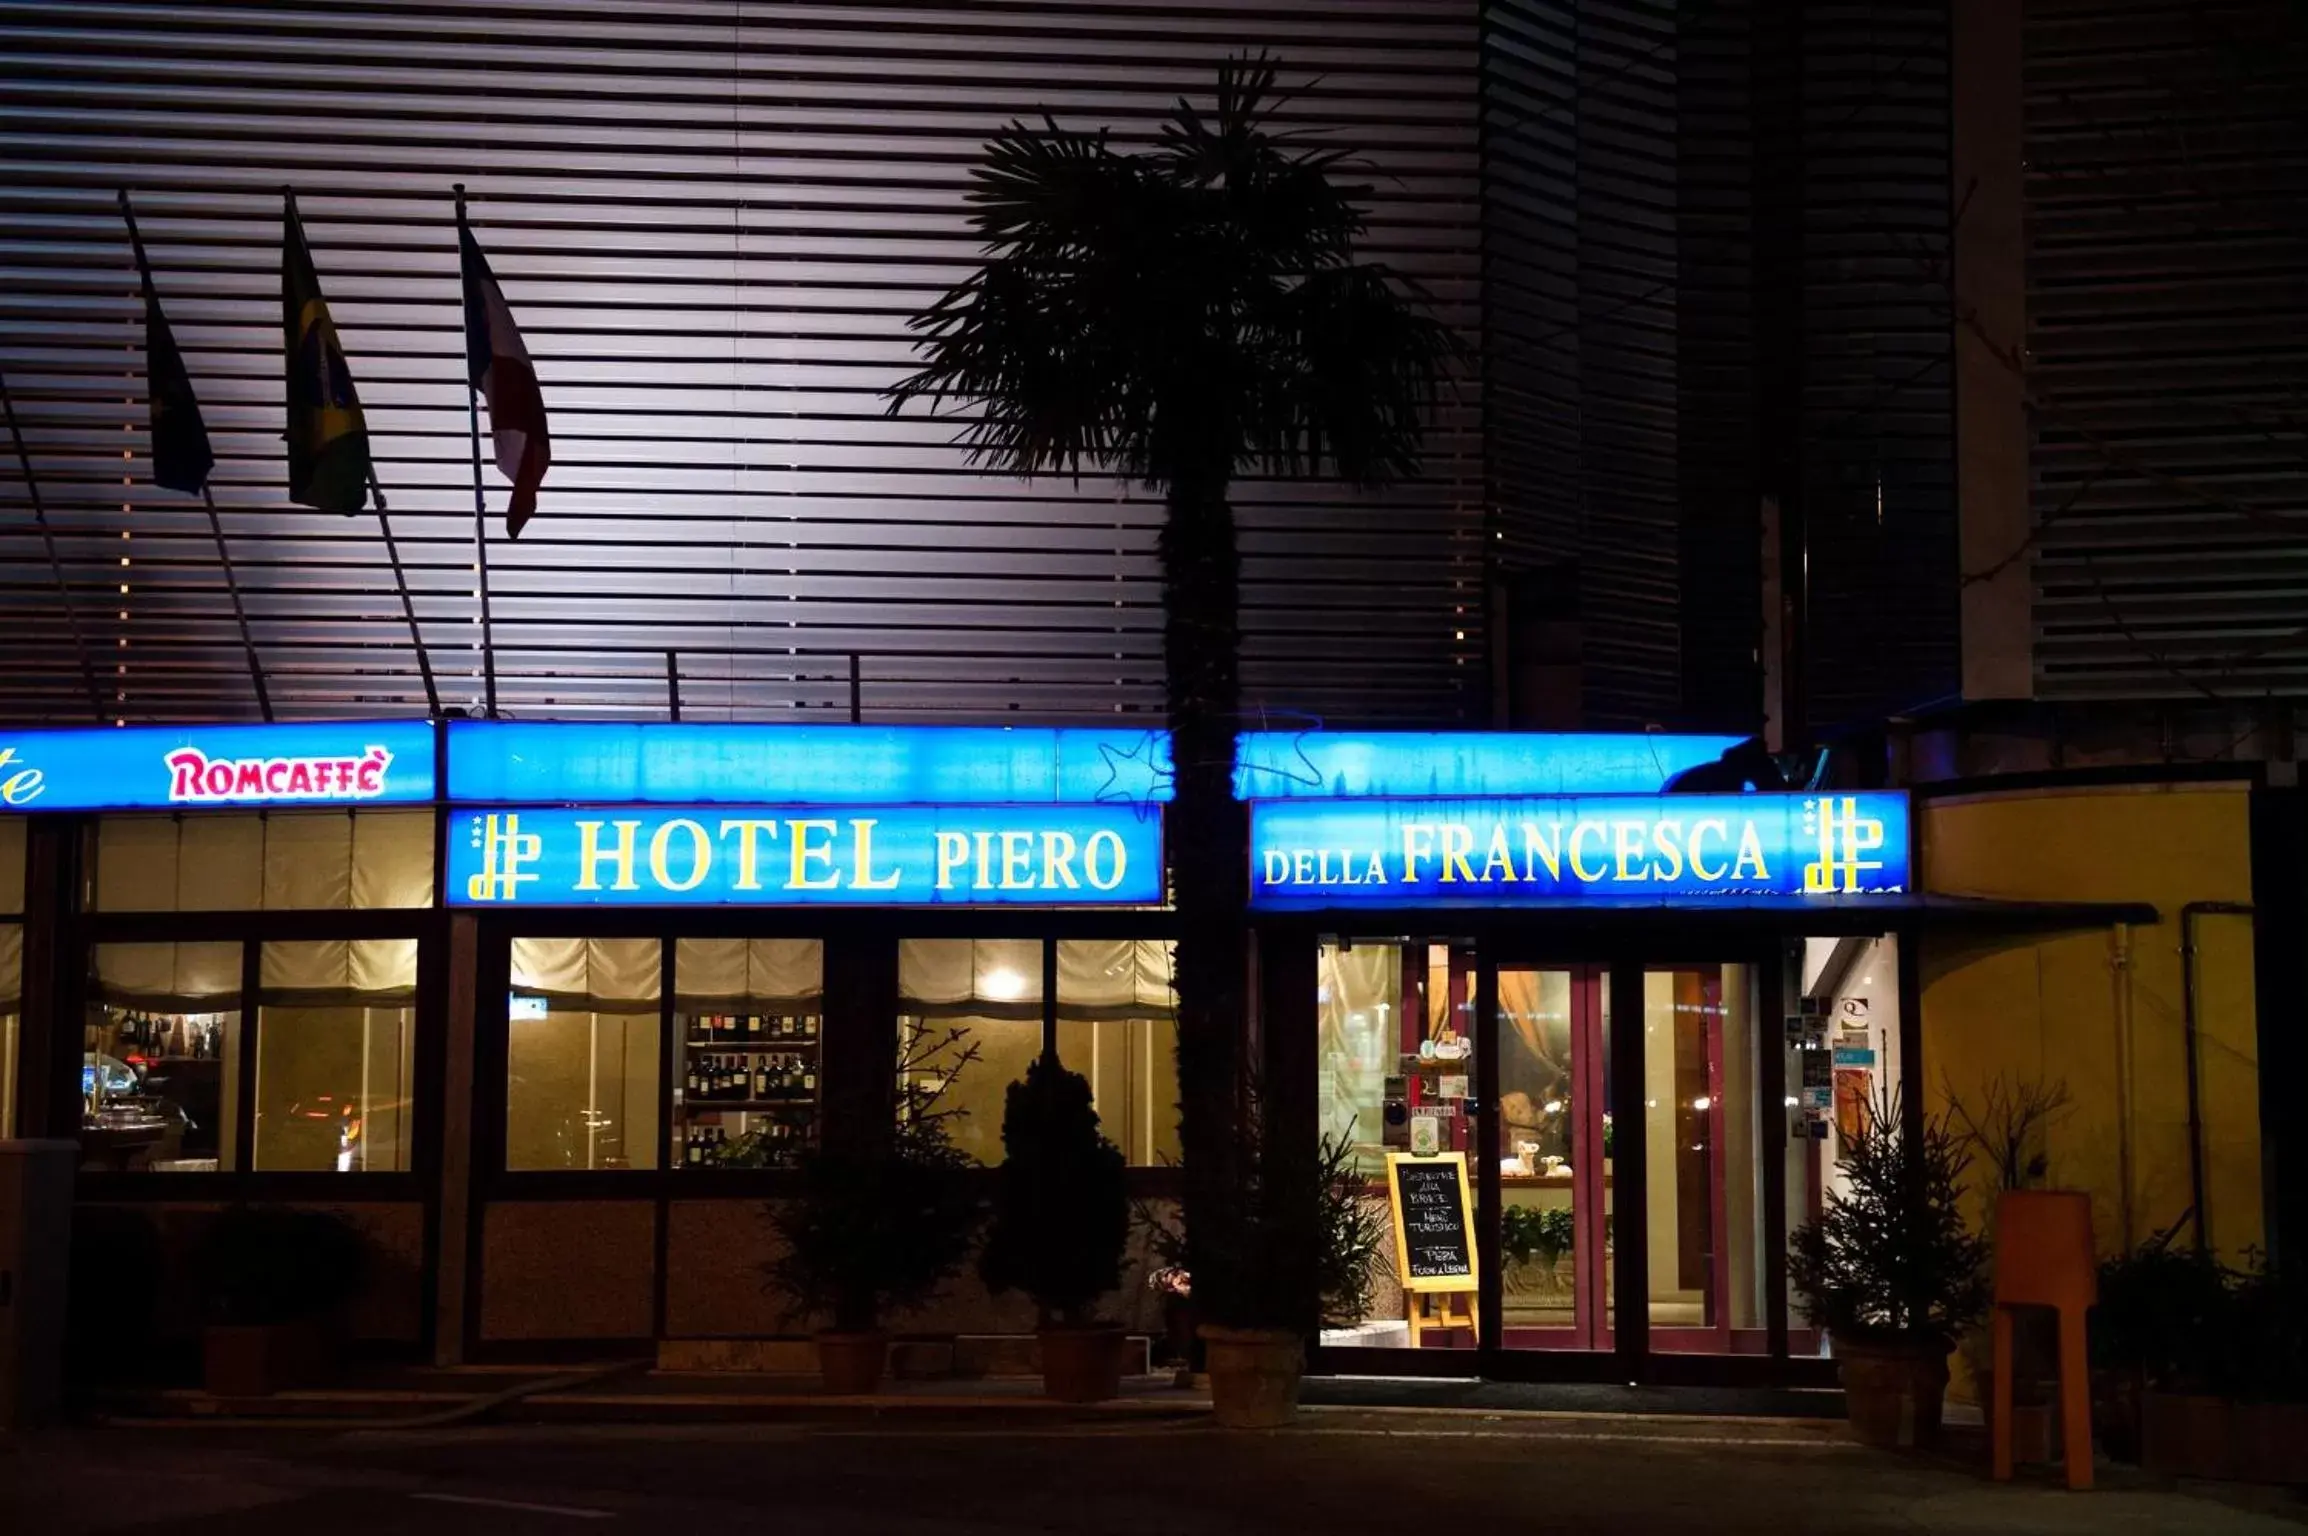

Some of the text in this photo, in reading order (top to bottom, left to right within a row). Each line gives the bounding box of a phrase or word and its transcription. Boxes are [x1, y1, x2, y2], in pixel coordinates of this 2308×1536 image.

[576, 819, 1127, 891] HOTEL PIERO
[1263, 818, 1769, 885] DELLA FRANCESCA
